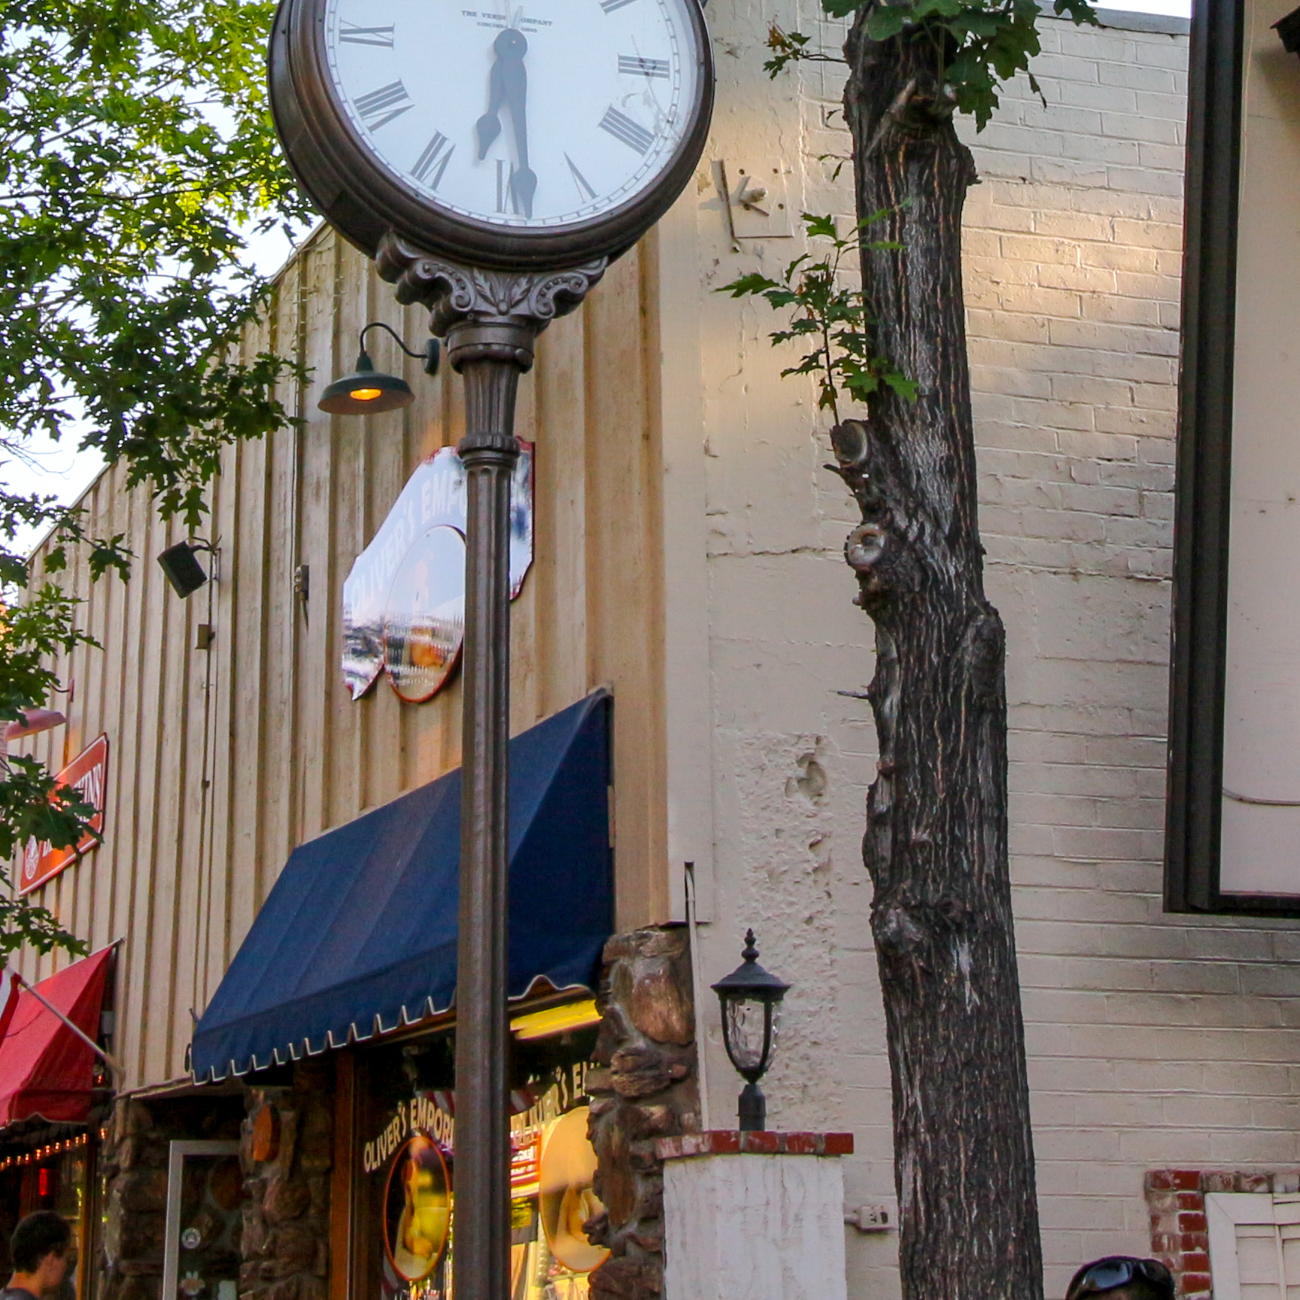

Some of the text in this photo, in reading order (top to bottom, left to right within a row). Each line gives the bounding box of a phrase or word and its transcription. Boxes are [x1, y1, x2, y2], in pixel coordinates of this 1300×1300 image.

[519, 17, 553, 27] OMPANY
[363, 1097, 455, 1173] OLIVER'S EMPORI
